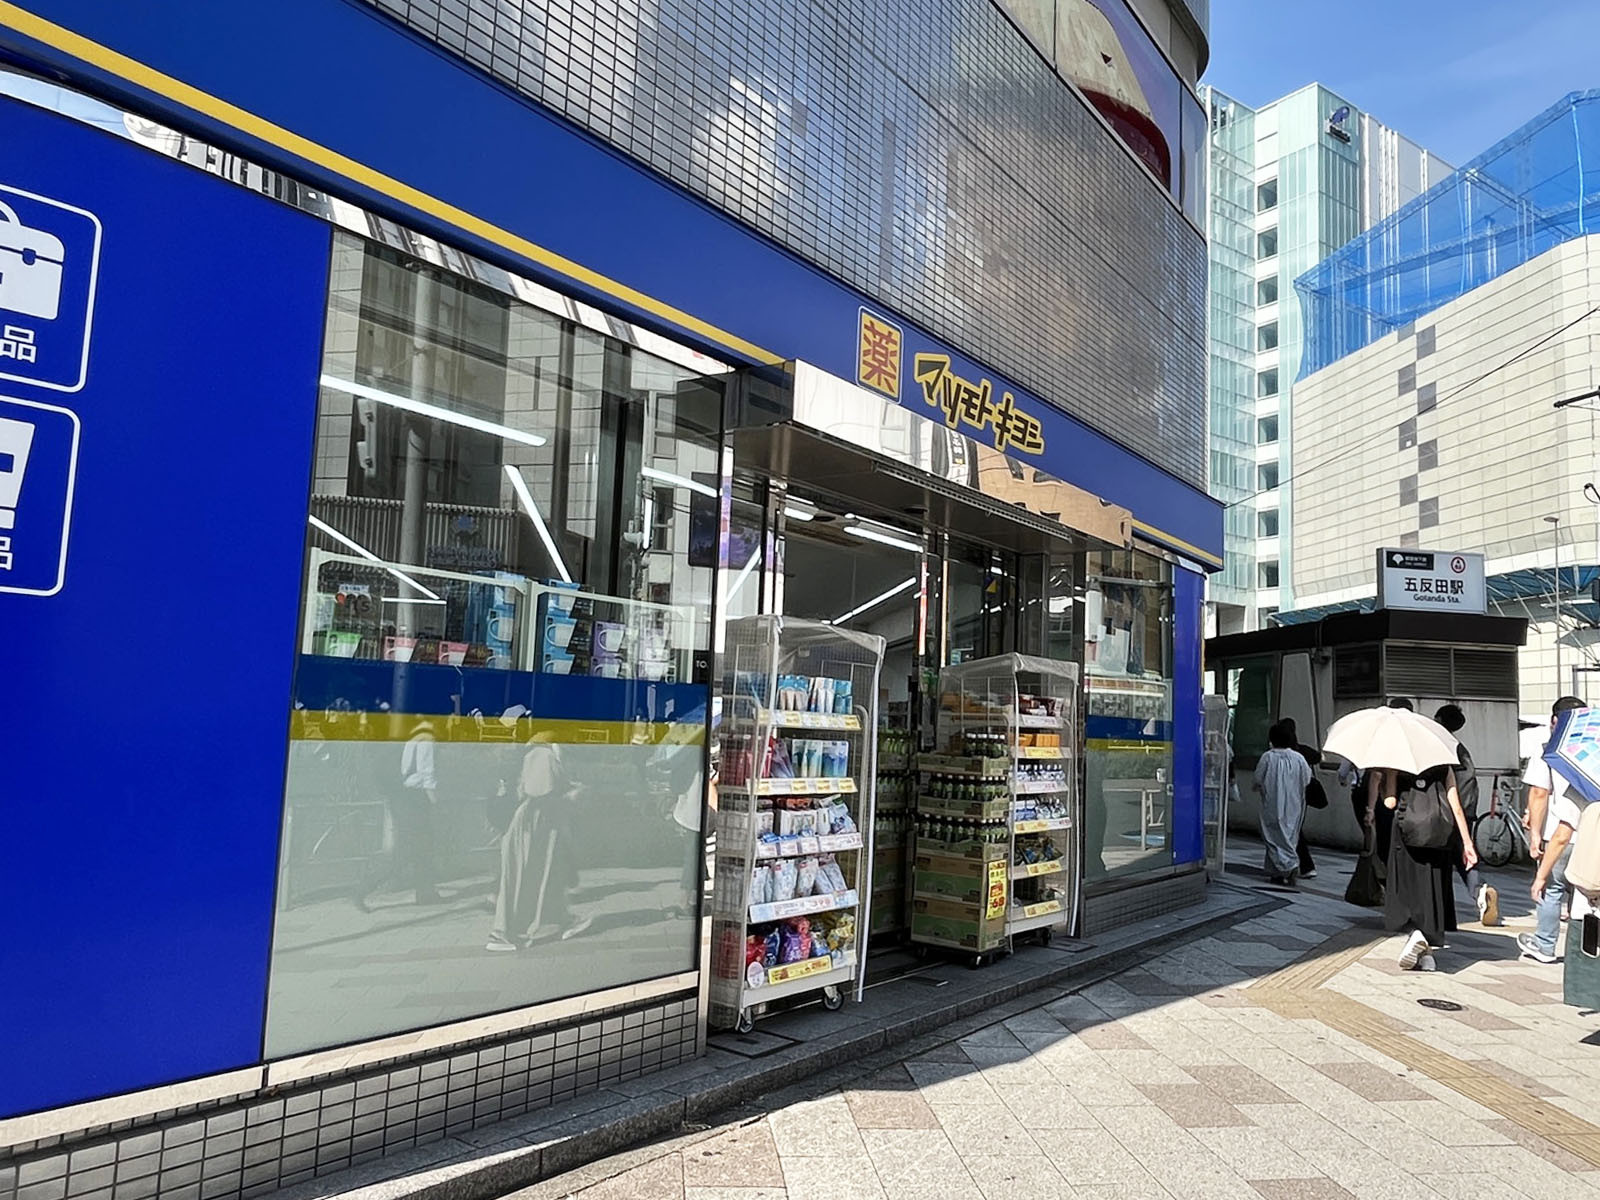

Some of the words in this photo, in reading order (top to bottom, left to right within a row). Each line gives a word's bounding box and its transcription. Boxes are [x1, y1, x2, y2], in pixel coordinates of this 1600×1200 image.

[0, 324, 36, 363] 品
[863, 320, 899, 393] 薬
[914, 352, 1045, 455] マツモトキヨシ
[1404, 577, 1464, 595] 五反田駅
[1413, 594, 1445, 603] Gotanda
[1447, 595, 1461, 604] Sta.
